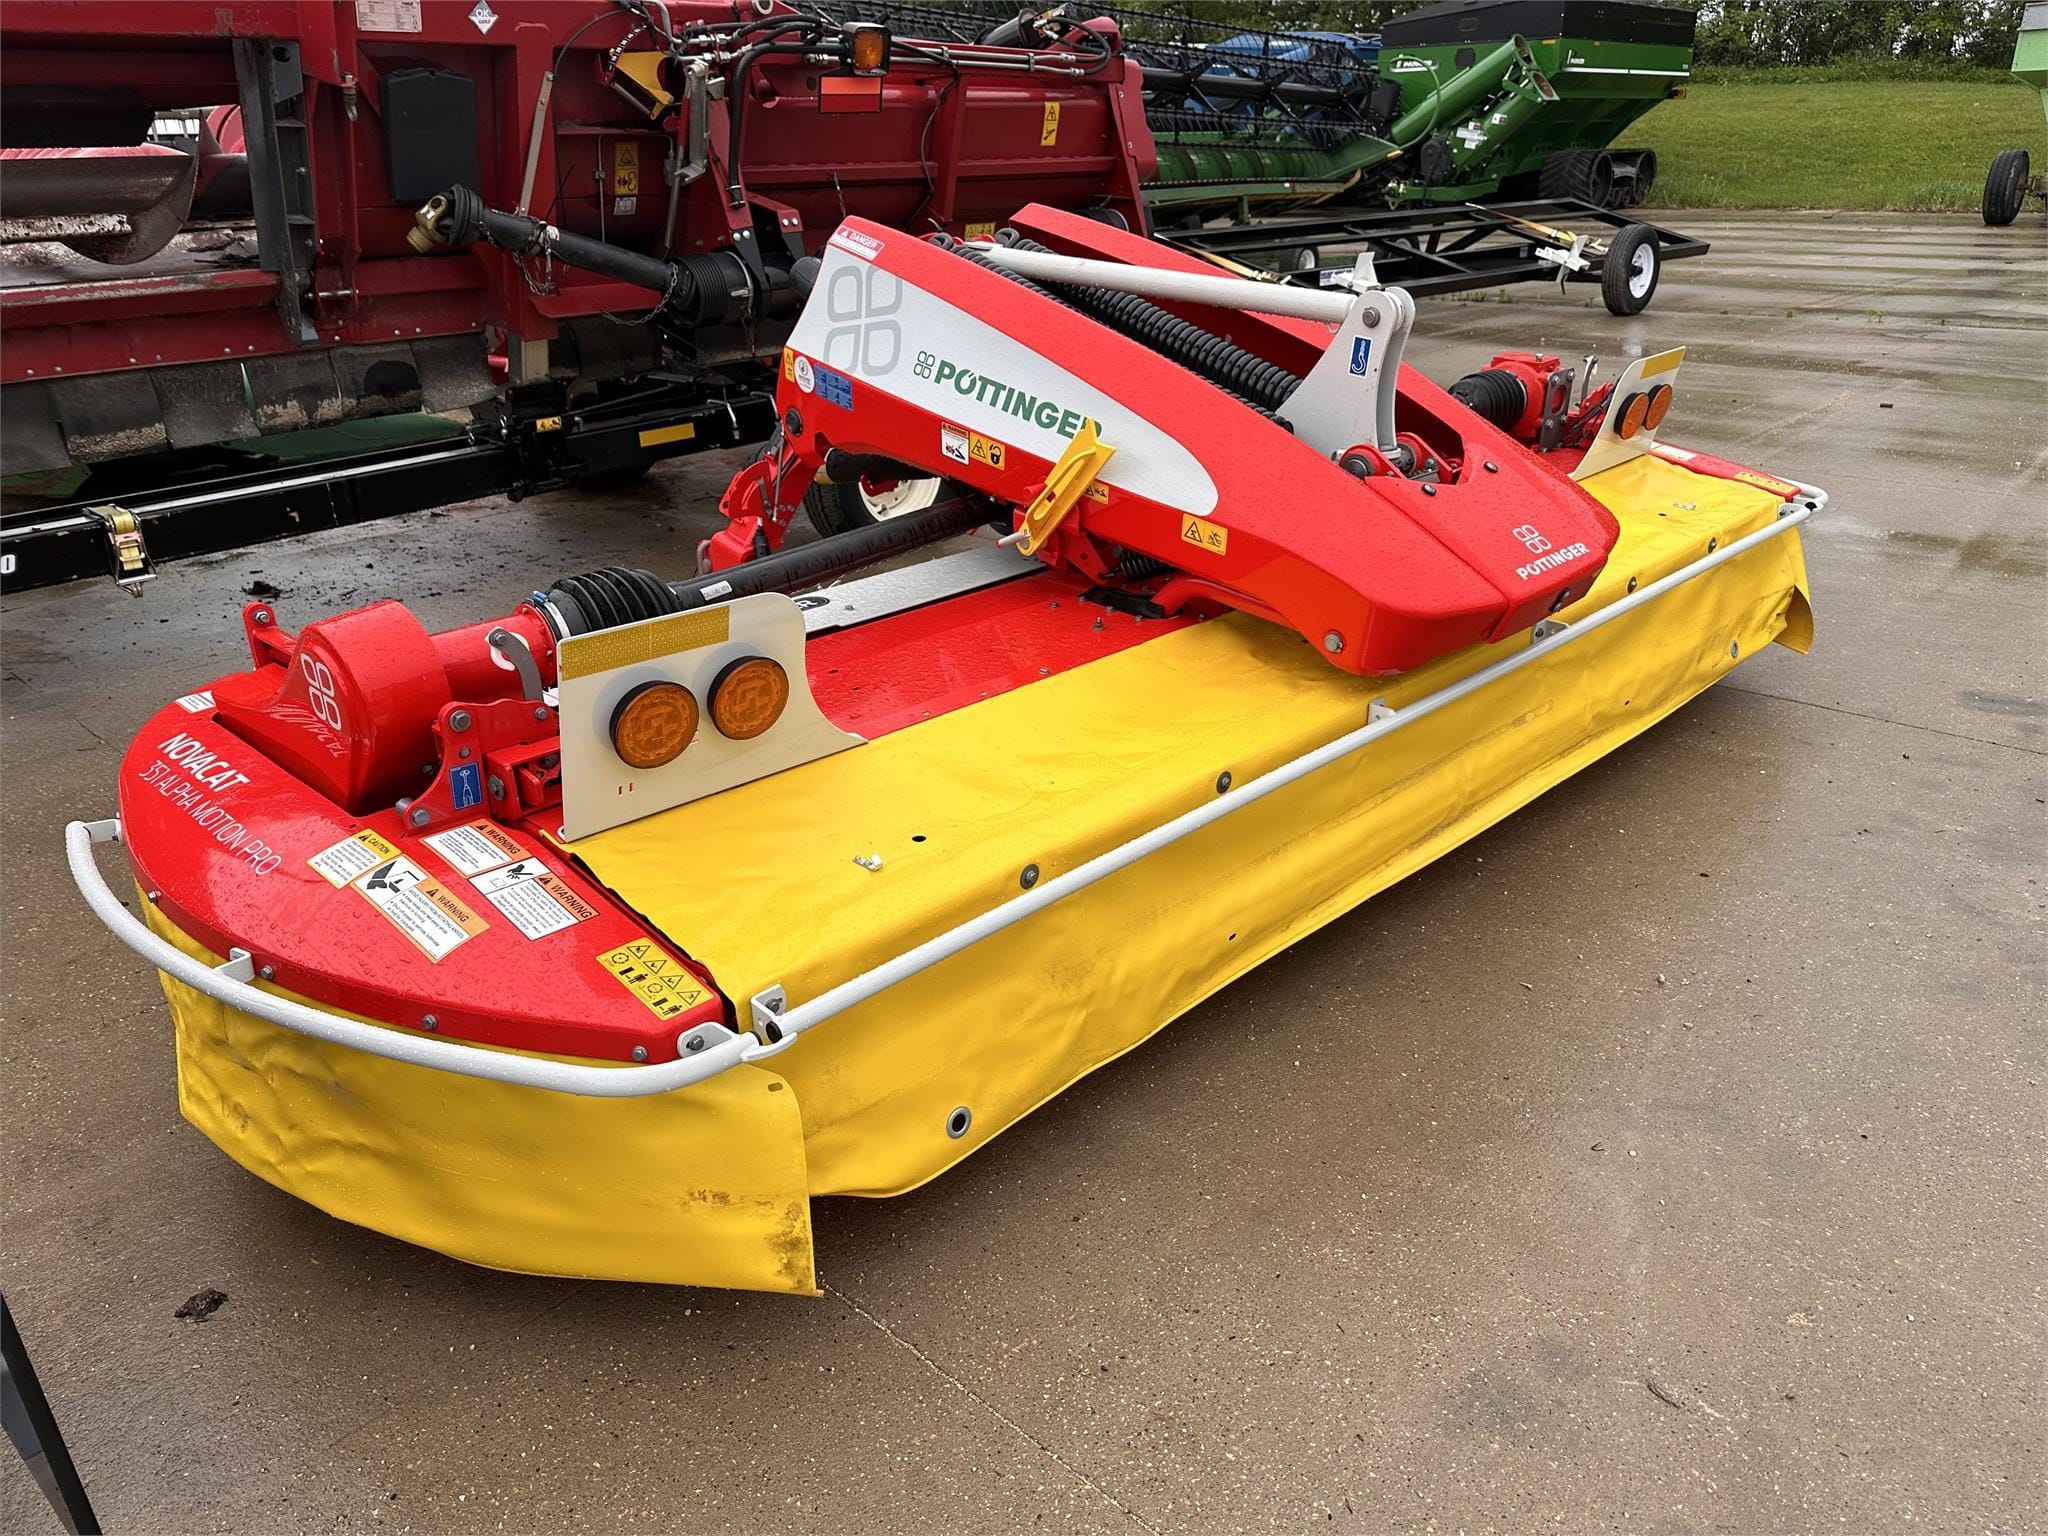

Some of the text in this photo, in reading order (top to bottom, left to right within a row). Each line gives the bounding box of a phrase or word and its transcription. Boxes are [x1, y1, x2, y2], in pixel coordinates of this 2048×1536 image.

[475, 9, 490, 18] OK
[850, 232, 878, 250] DANGER
[138, 760, 171, 784] 351
[157, 732, 250, 792] NOVACAT
[154, 773, 201, 811] ALPHA
[188, 800, 253, 851] MOTION
[368, 837, 391, 855] CAUTION
[486, 828, 521, 855] WARNING
[236, 839, 282, 876] PRO
[438, 895, 469, 923] WARNING
[551, 884, 593, 919] WARNING
